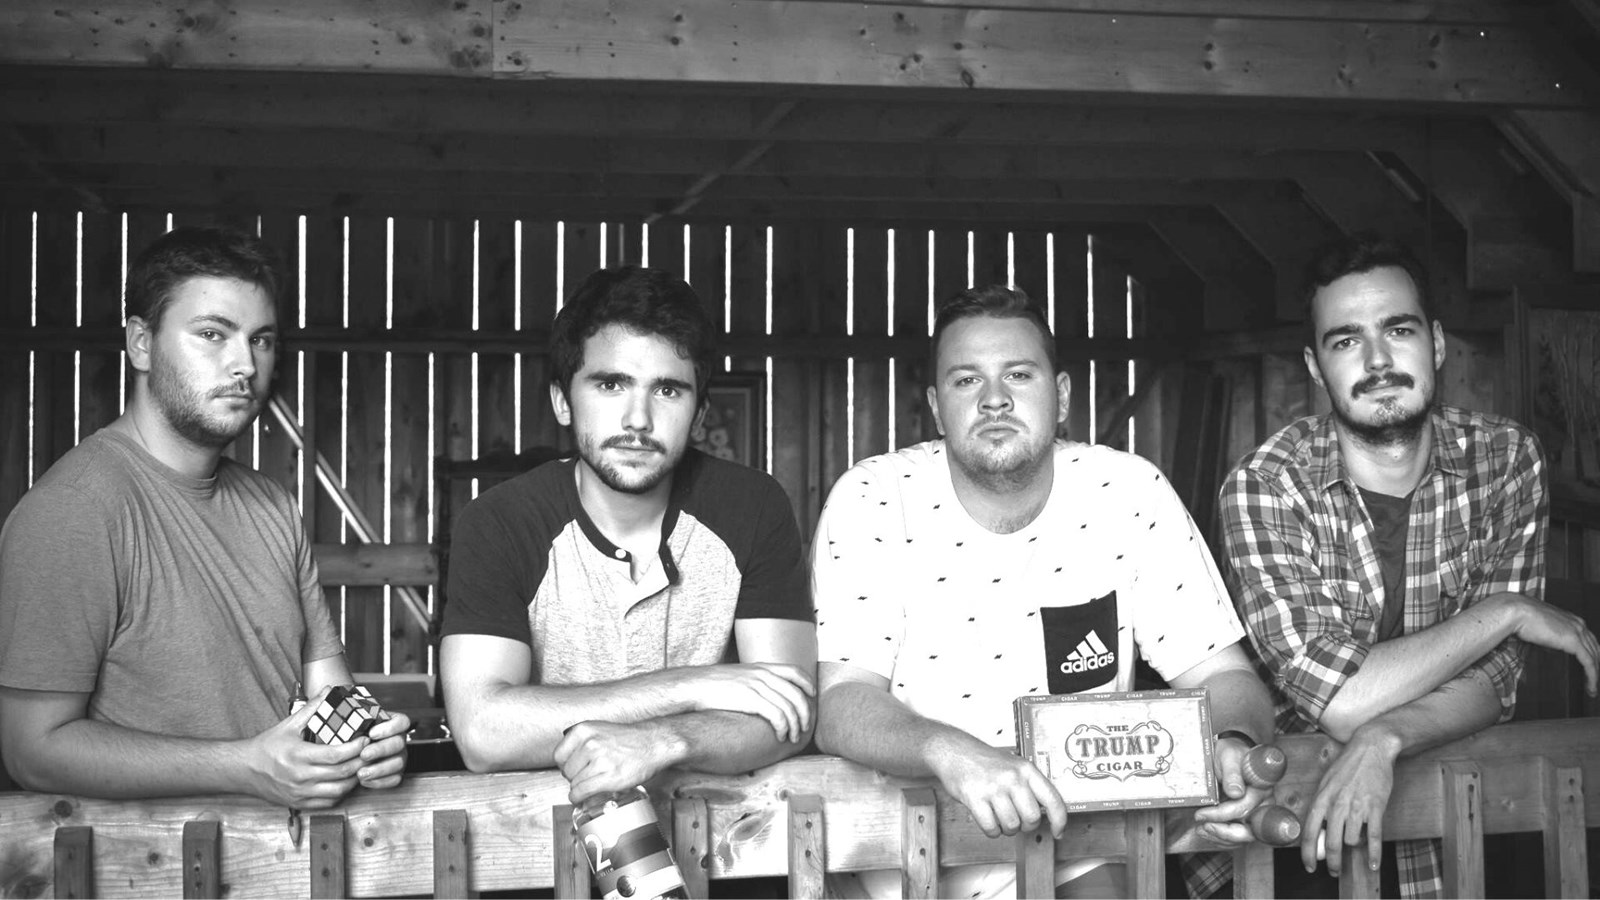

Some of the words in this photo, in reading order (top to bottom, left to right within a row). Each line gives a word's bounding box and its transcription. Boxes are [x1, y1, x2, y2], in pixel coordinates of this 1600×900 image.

[1060, 651, 1115, 674] adidas
[1075, 735, 1160, 757] TRUMP
[1096, 761, 1143, 771] CIGAR
[584, 833, 612, 872] 2
